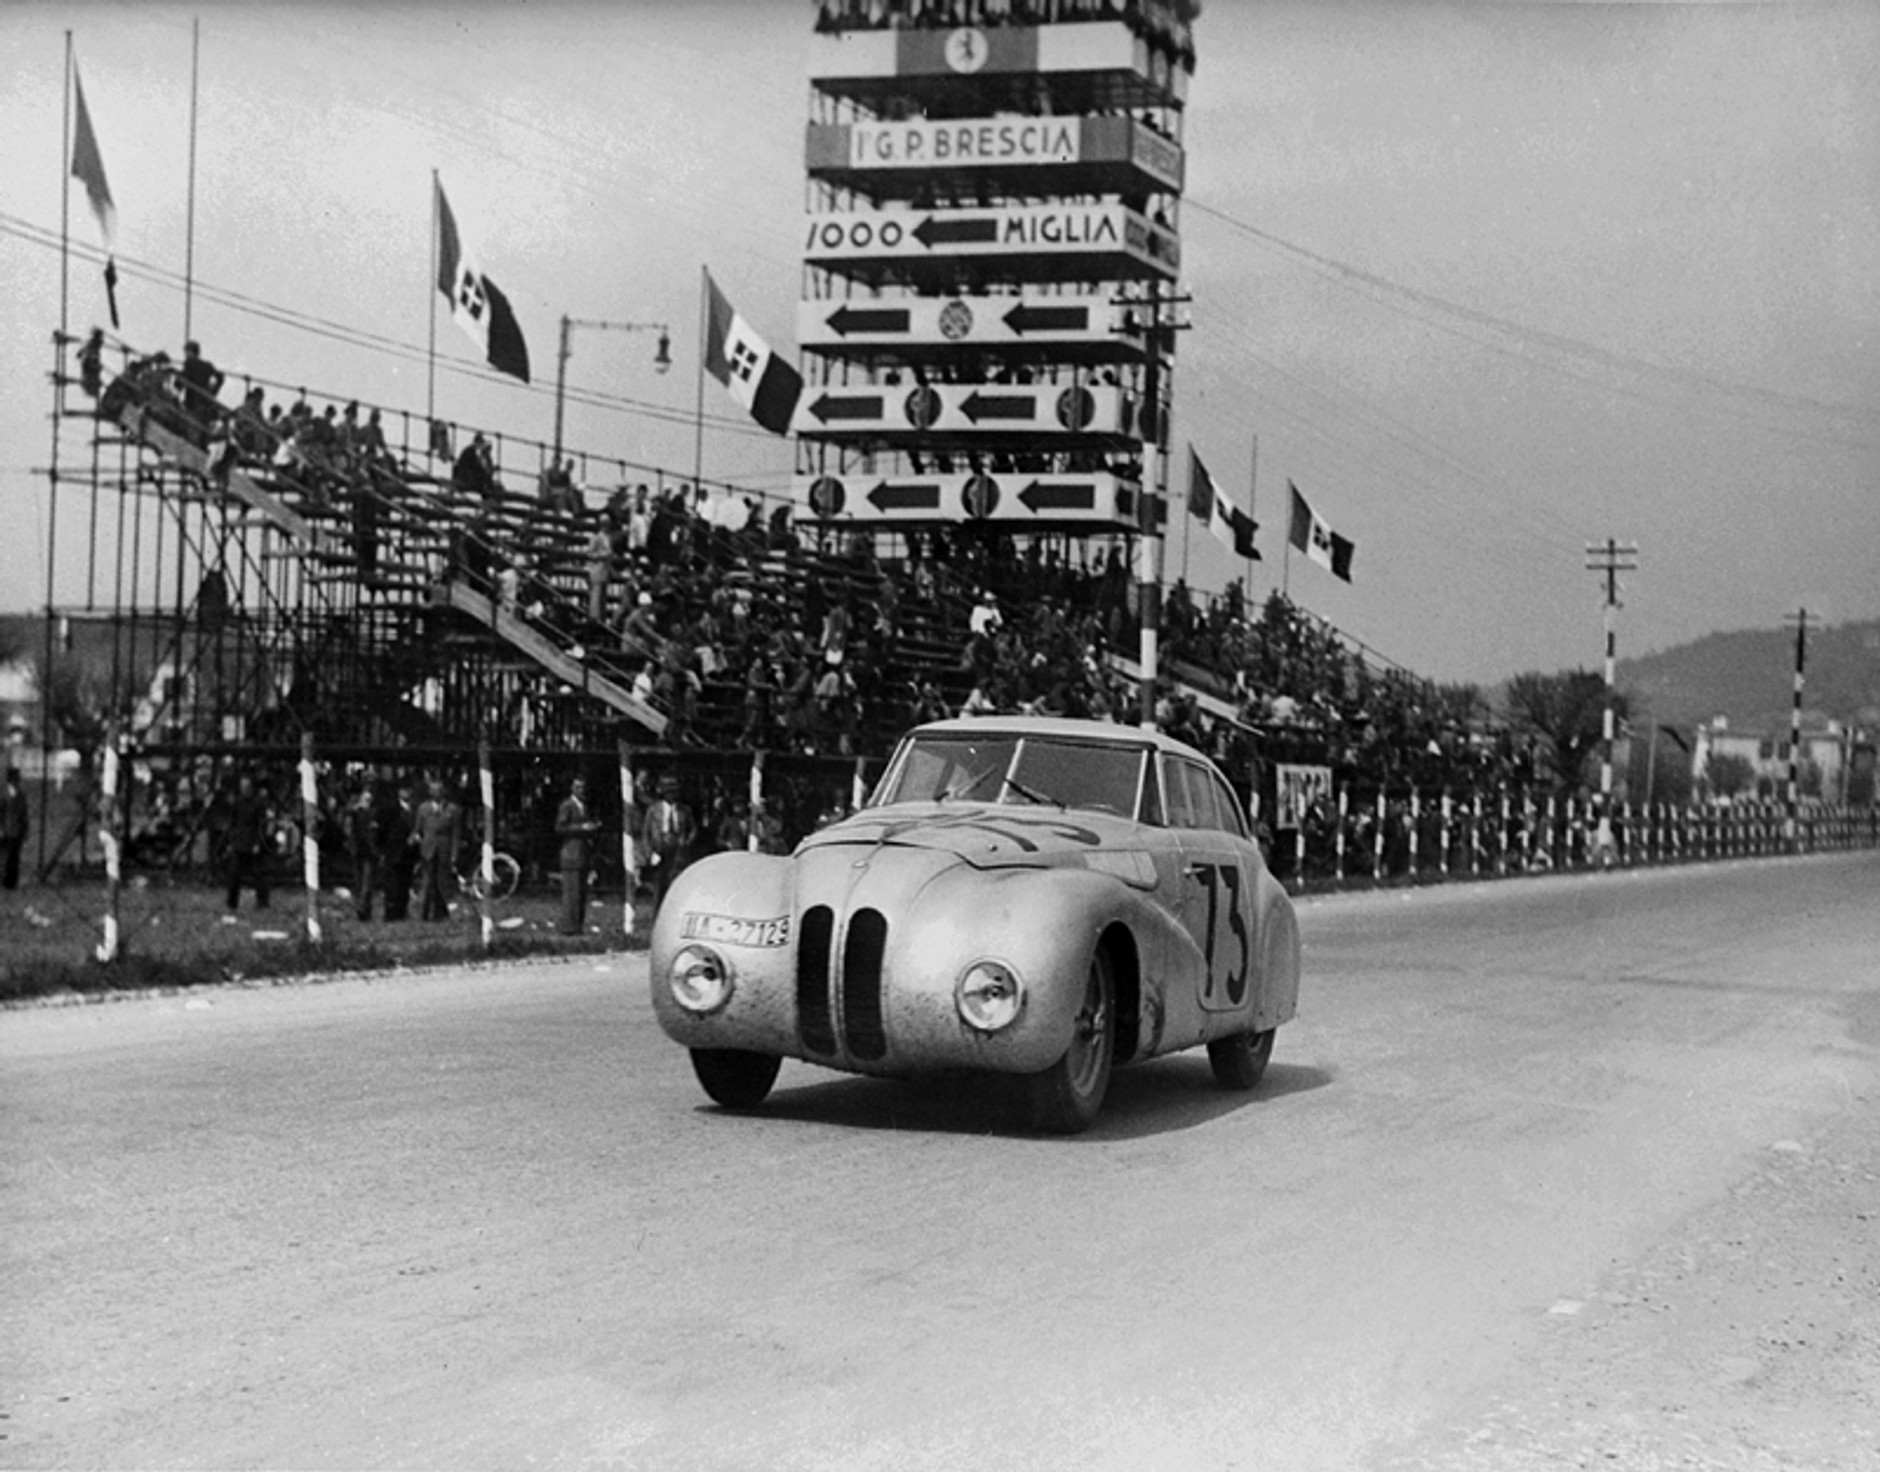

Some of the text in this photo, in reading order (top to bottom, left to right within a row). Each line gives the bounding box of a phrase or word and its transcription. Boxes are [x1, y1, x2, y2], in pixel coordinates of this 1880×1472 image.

[934, 126, 1074, 158] BRESCIA
[805, 221, 903, 250] 1000
[1003, 214, 1118, 244] MIGLIA
[1191, 861, 1249, 1005] 73
